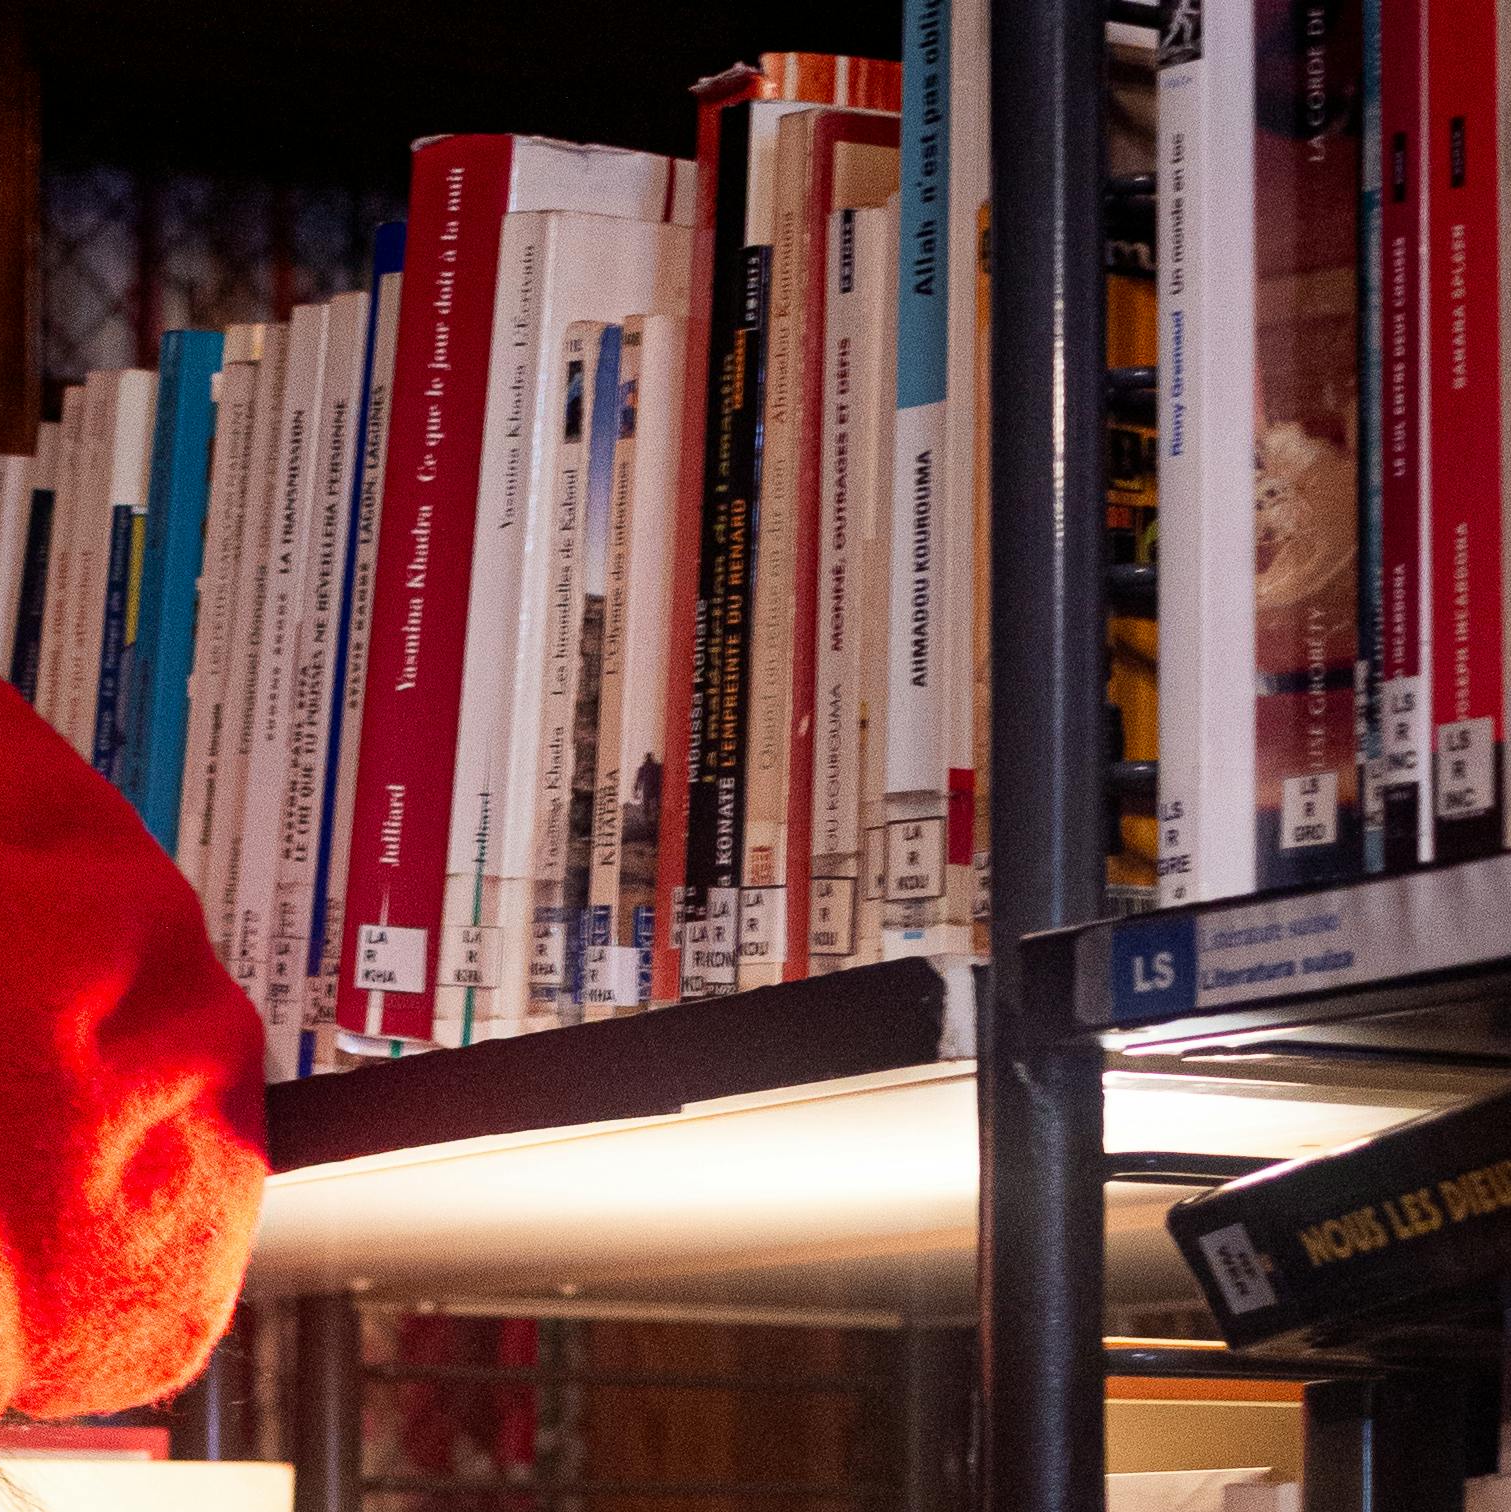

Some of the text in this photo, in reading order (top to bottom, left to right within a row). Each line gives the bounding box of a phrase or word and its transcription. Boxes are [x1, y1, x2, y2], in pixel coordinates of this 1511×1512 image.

[913, 73, 942, 296] Allah n'est pas
[1169, 168, 1185, 295] Un monde en
[415, 167, 464, 483] Ce que le jour doit à la nuit
[1449, 224, 1468, 389] BANANA SPLEEN
[325, 399, 349, 497] PERSONNE
[504, 364, 527, 438] Khadra
[835, 403, 849, 425] ET
[279, 407, 306, 576] LA TRANSMISSION
[832, 433, 850, 551] OUTRAGES
[394, 503, 435, 691] Yasmina Khadra
[550, 469, 579, 697] Les hirondelles de Kaboul
[909, 449, 933, 687] AHMADOU KOUROUMA
[720, 498, 747, 767] L'EMPREINTE DU RENARD
[546, 726, 565, 791] Khadra
[826, 684, 843, 811] KOUROUMA
[380, 784, 406, 868] Julliard
[1161, 800, 1184, 822] LS
[1167, 828, 1180, 848] R
[1133, 951, 1176, 994] LS
[1297, 1186, 1444, 1267] NOUS LES
